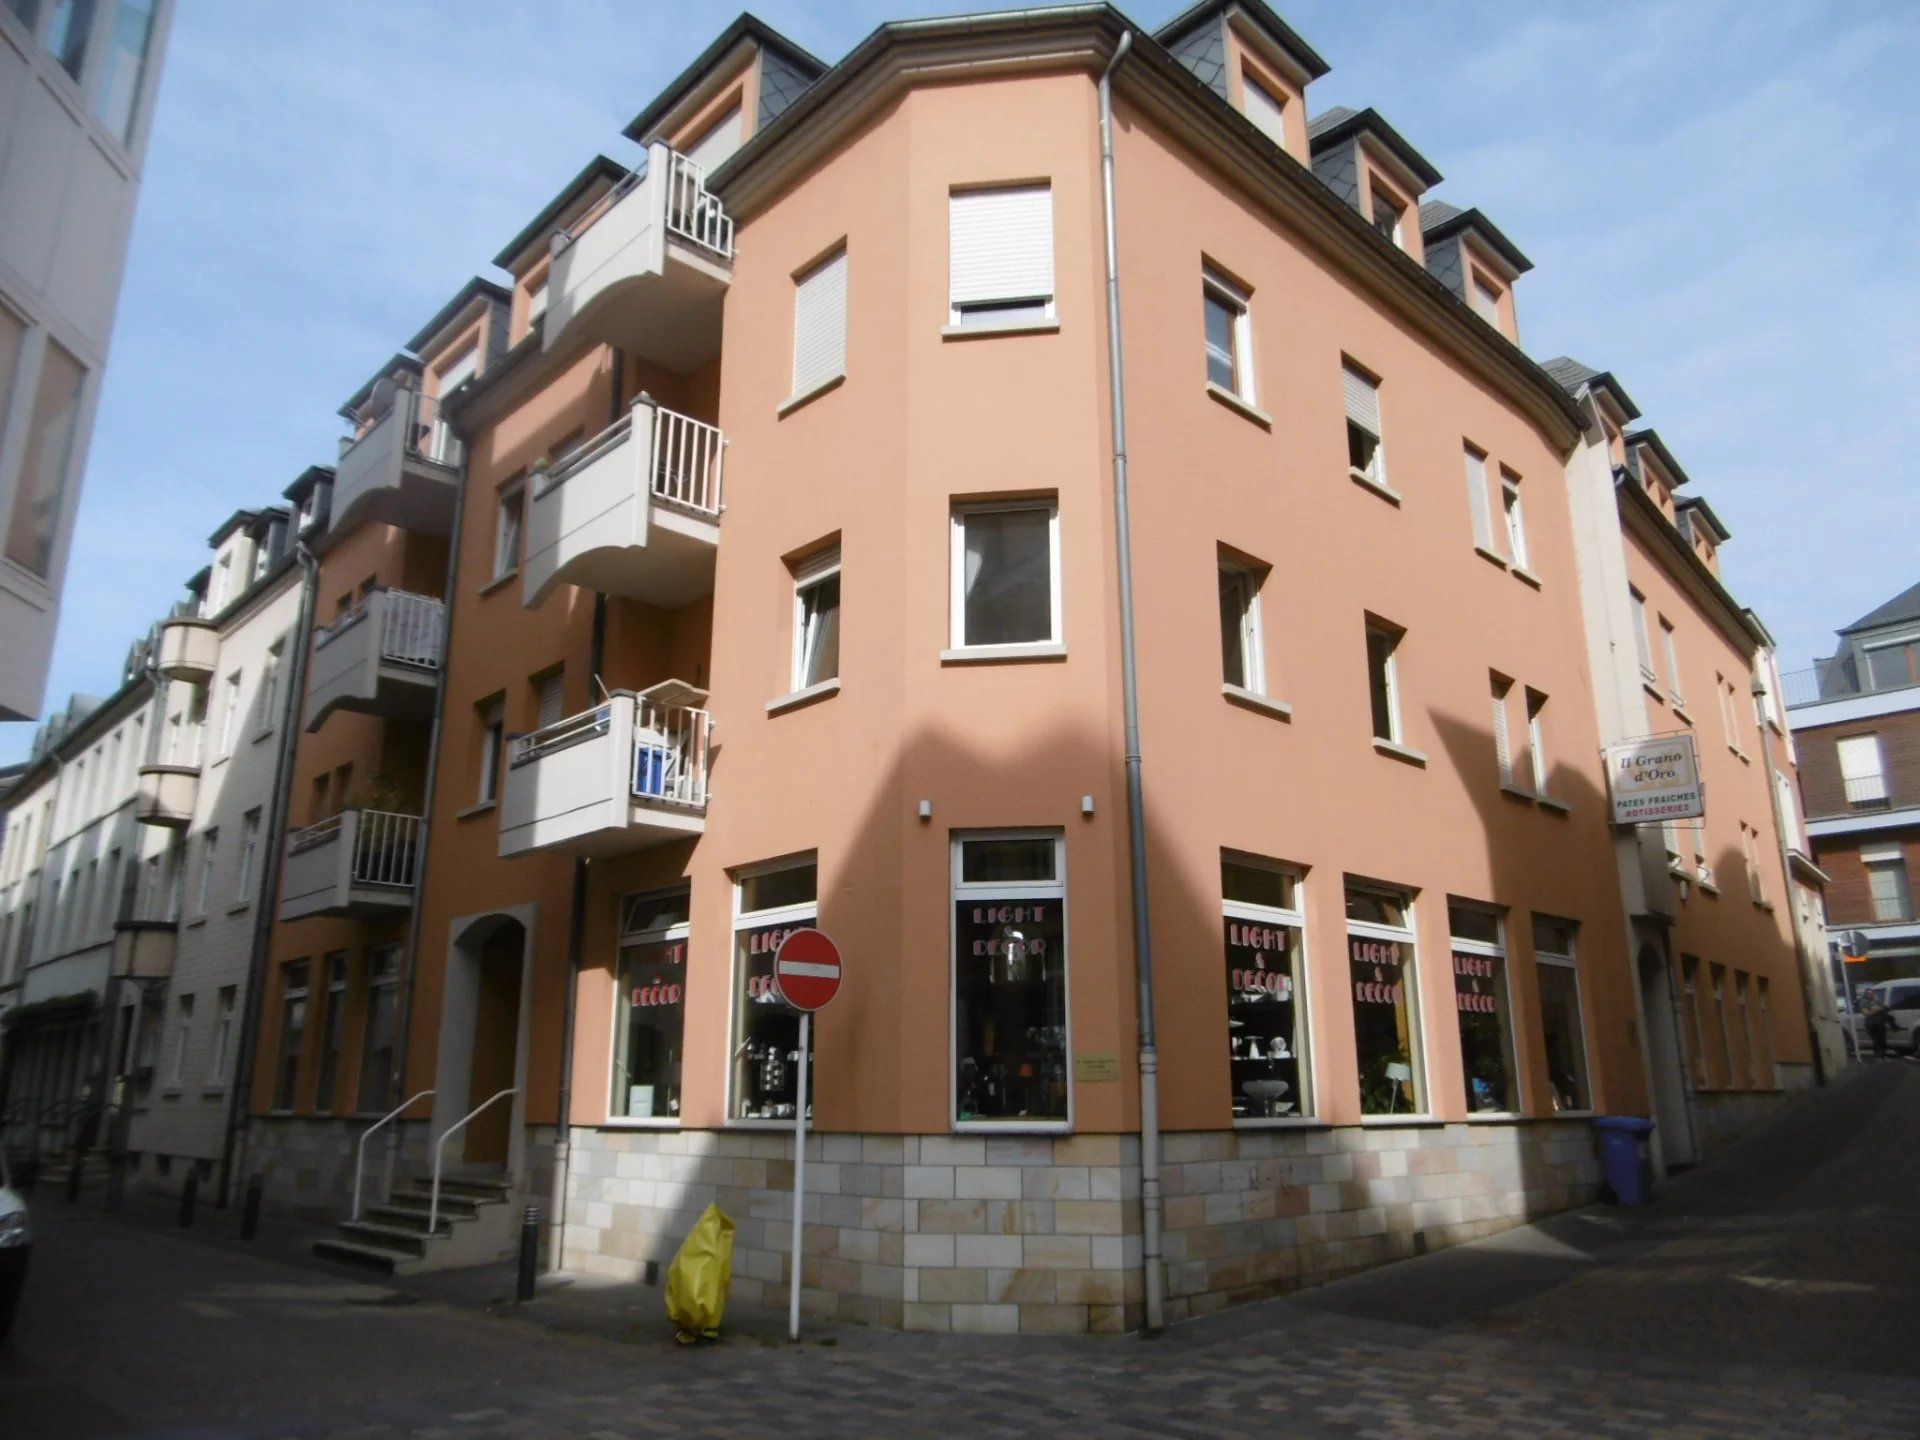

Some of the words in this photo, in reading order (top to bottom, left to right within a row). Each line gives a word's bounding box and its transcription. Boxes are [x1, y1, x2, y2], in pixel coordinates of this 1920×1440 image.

[1620, 757, 1630, 769] Il
[1635, 753, 1682, 767] Grano
[1634, 769, 1675, 782] d'Oro
[973, 906, 1046, 924] LIGHT
[1230, 924, 1286, 951] LIGHT
[1353, 942, 1399, 965] LIGHT
[1454, 957, 1494, 977] LIGHT
[632, 984, 681, 1006] DECOR
